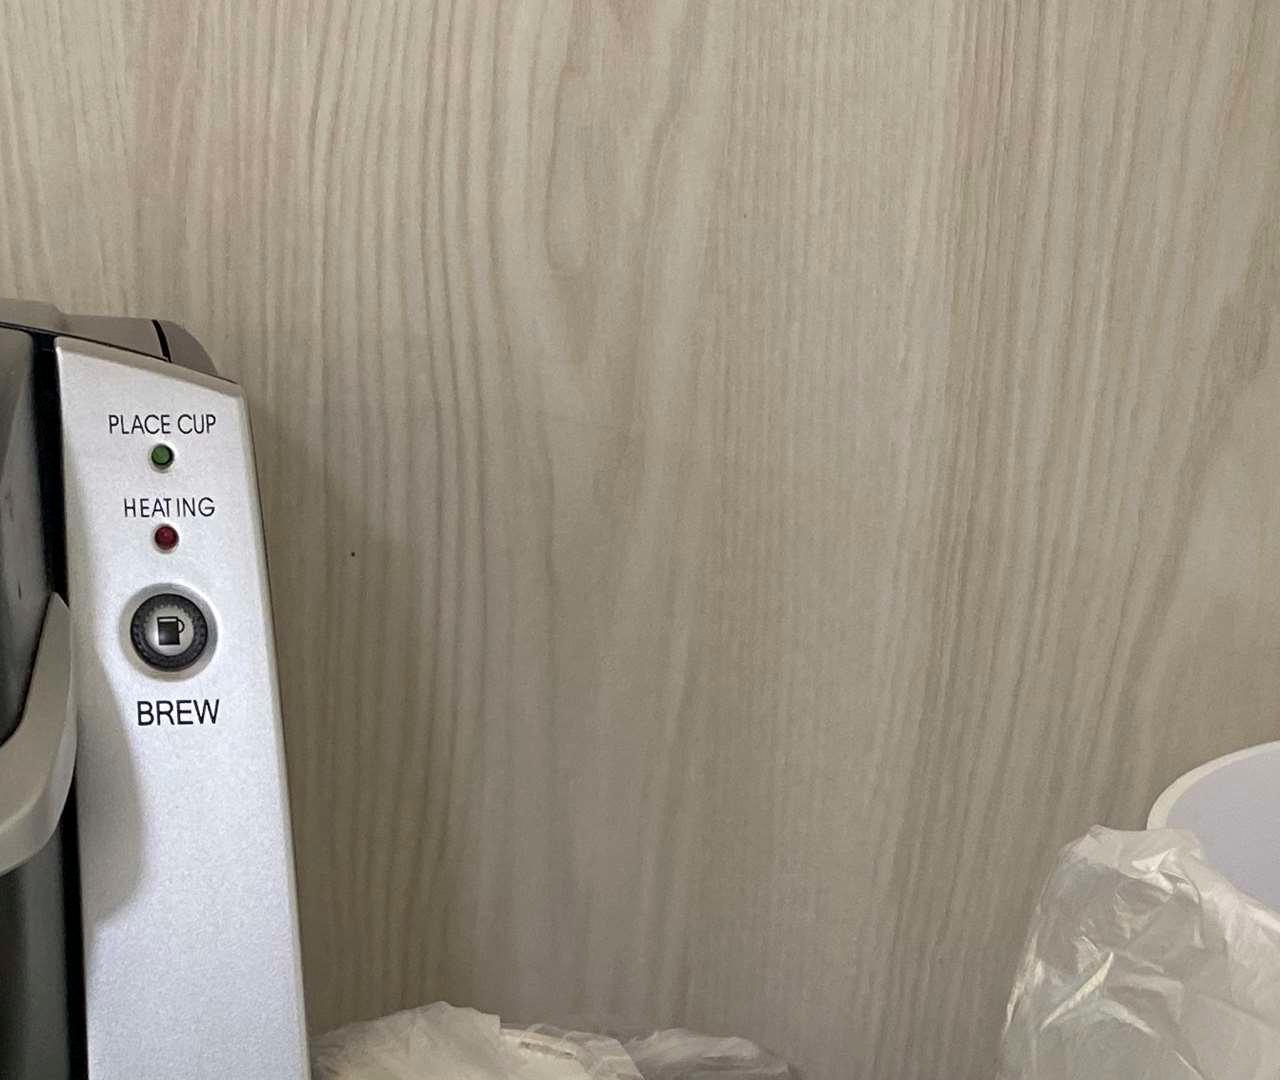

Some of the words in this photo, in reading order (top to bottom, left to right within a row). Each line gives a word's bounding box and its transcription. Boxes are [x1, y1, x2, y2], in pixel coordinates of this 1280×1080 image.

[108, 414, 171, 434] PLACE
[177, 414, 216, 434] CUP
[123, 497, 215, 518] HEATING
[137, 699, 219, 726] BREW
